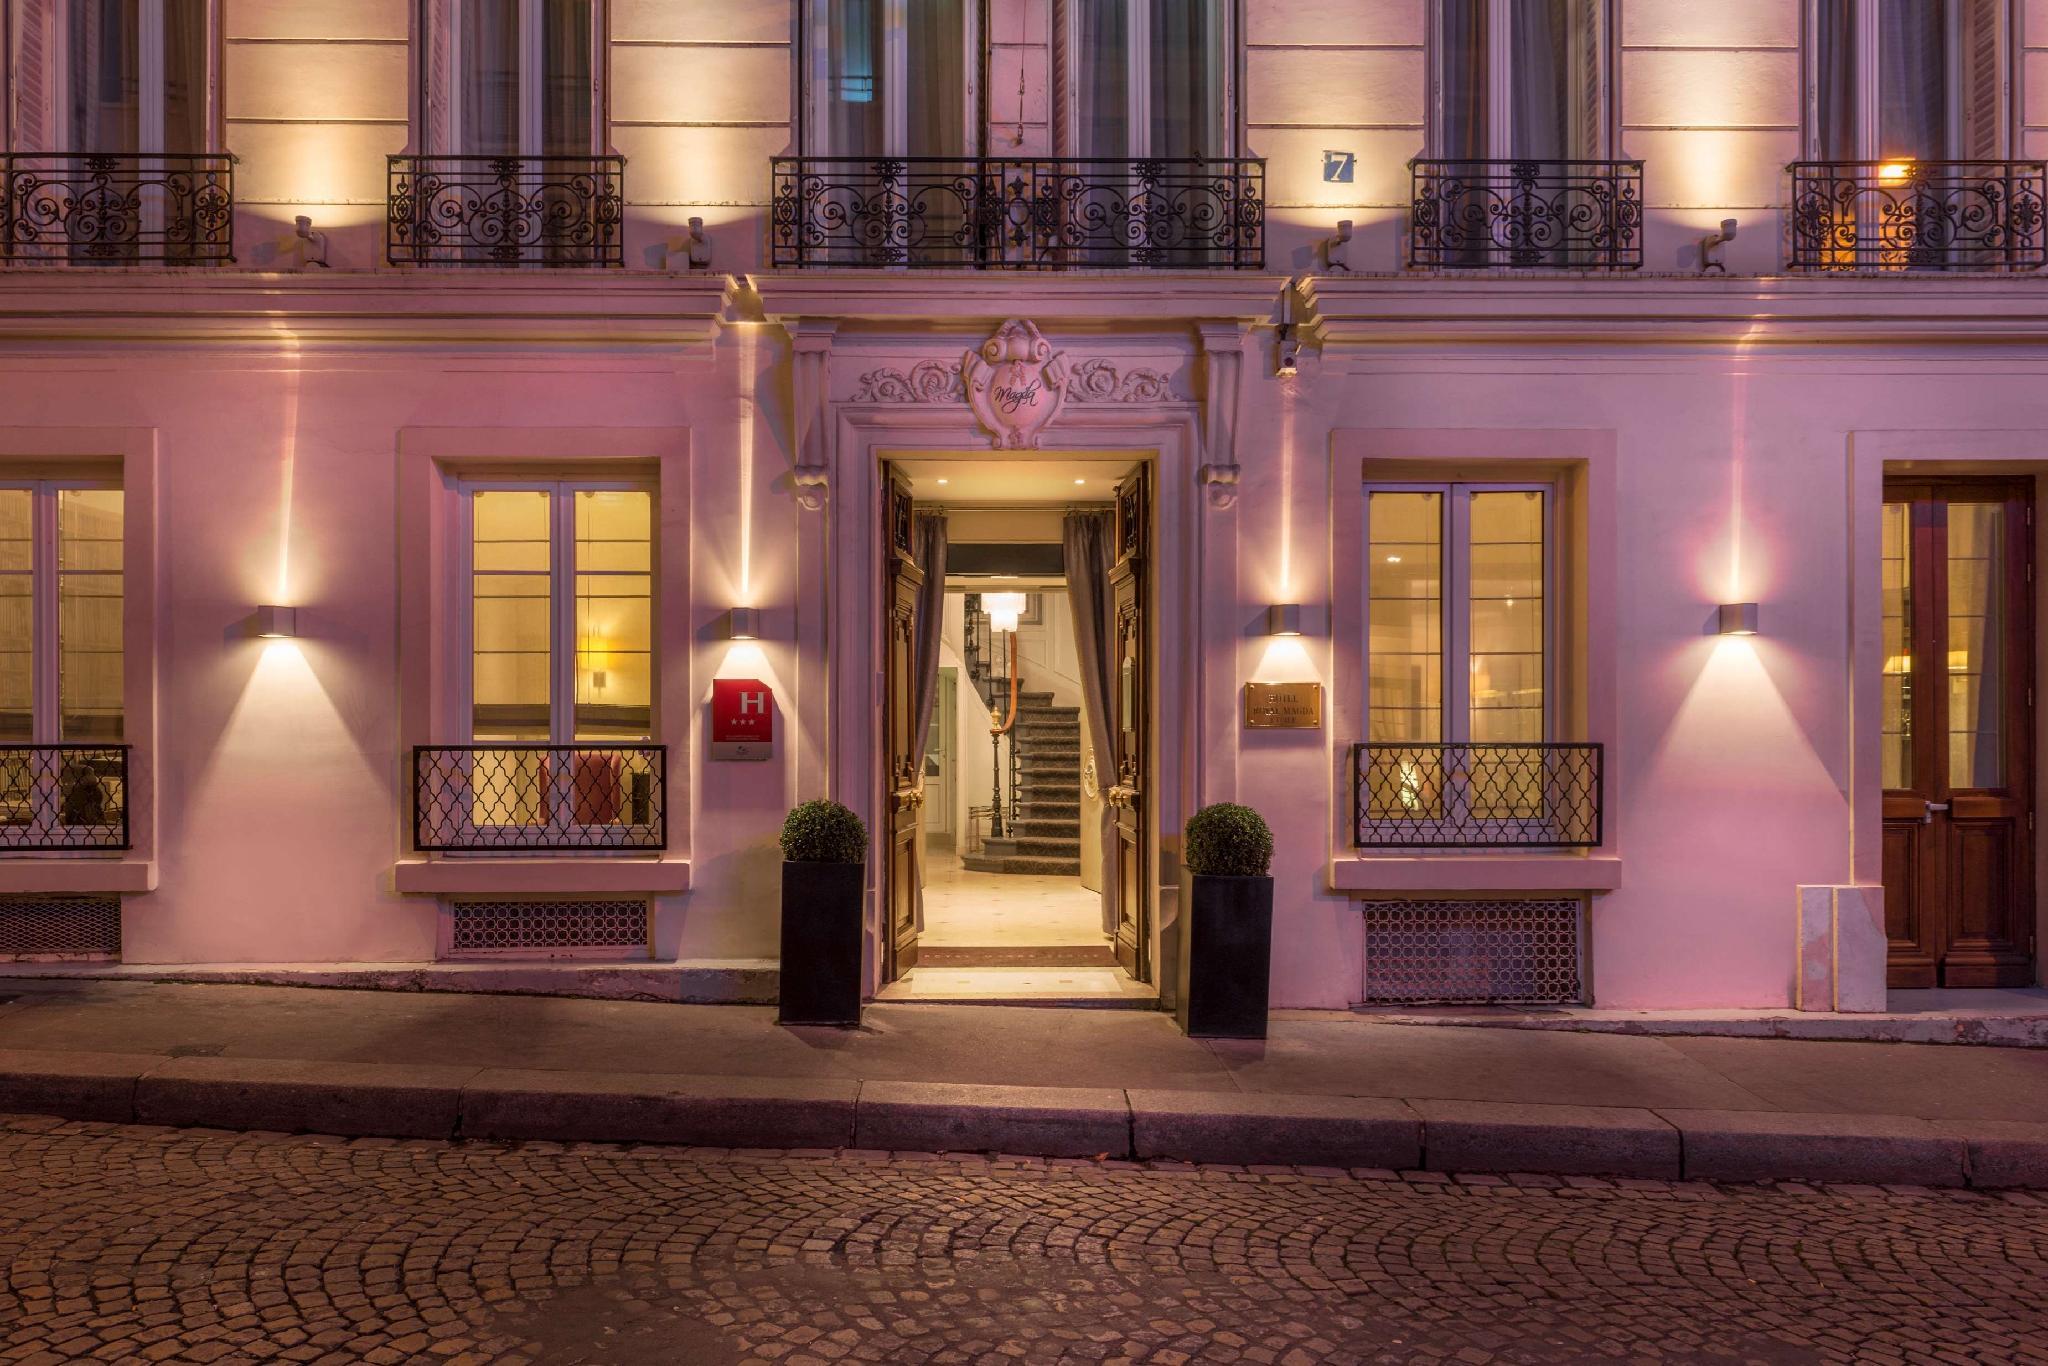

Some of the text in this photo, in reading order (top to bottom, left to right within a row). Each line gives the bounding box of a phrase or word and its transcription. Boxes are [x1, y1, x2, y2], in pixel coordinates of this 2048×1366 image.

[1330, 153, 1348, 181] 7
[994, 378, 1041, 414] Magda
[741, 691, 764, 714] H
[1283, 706, 1314, 715] MAGDA
